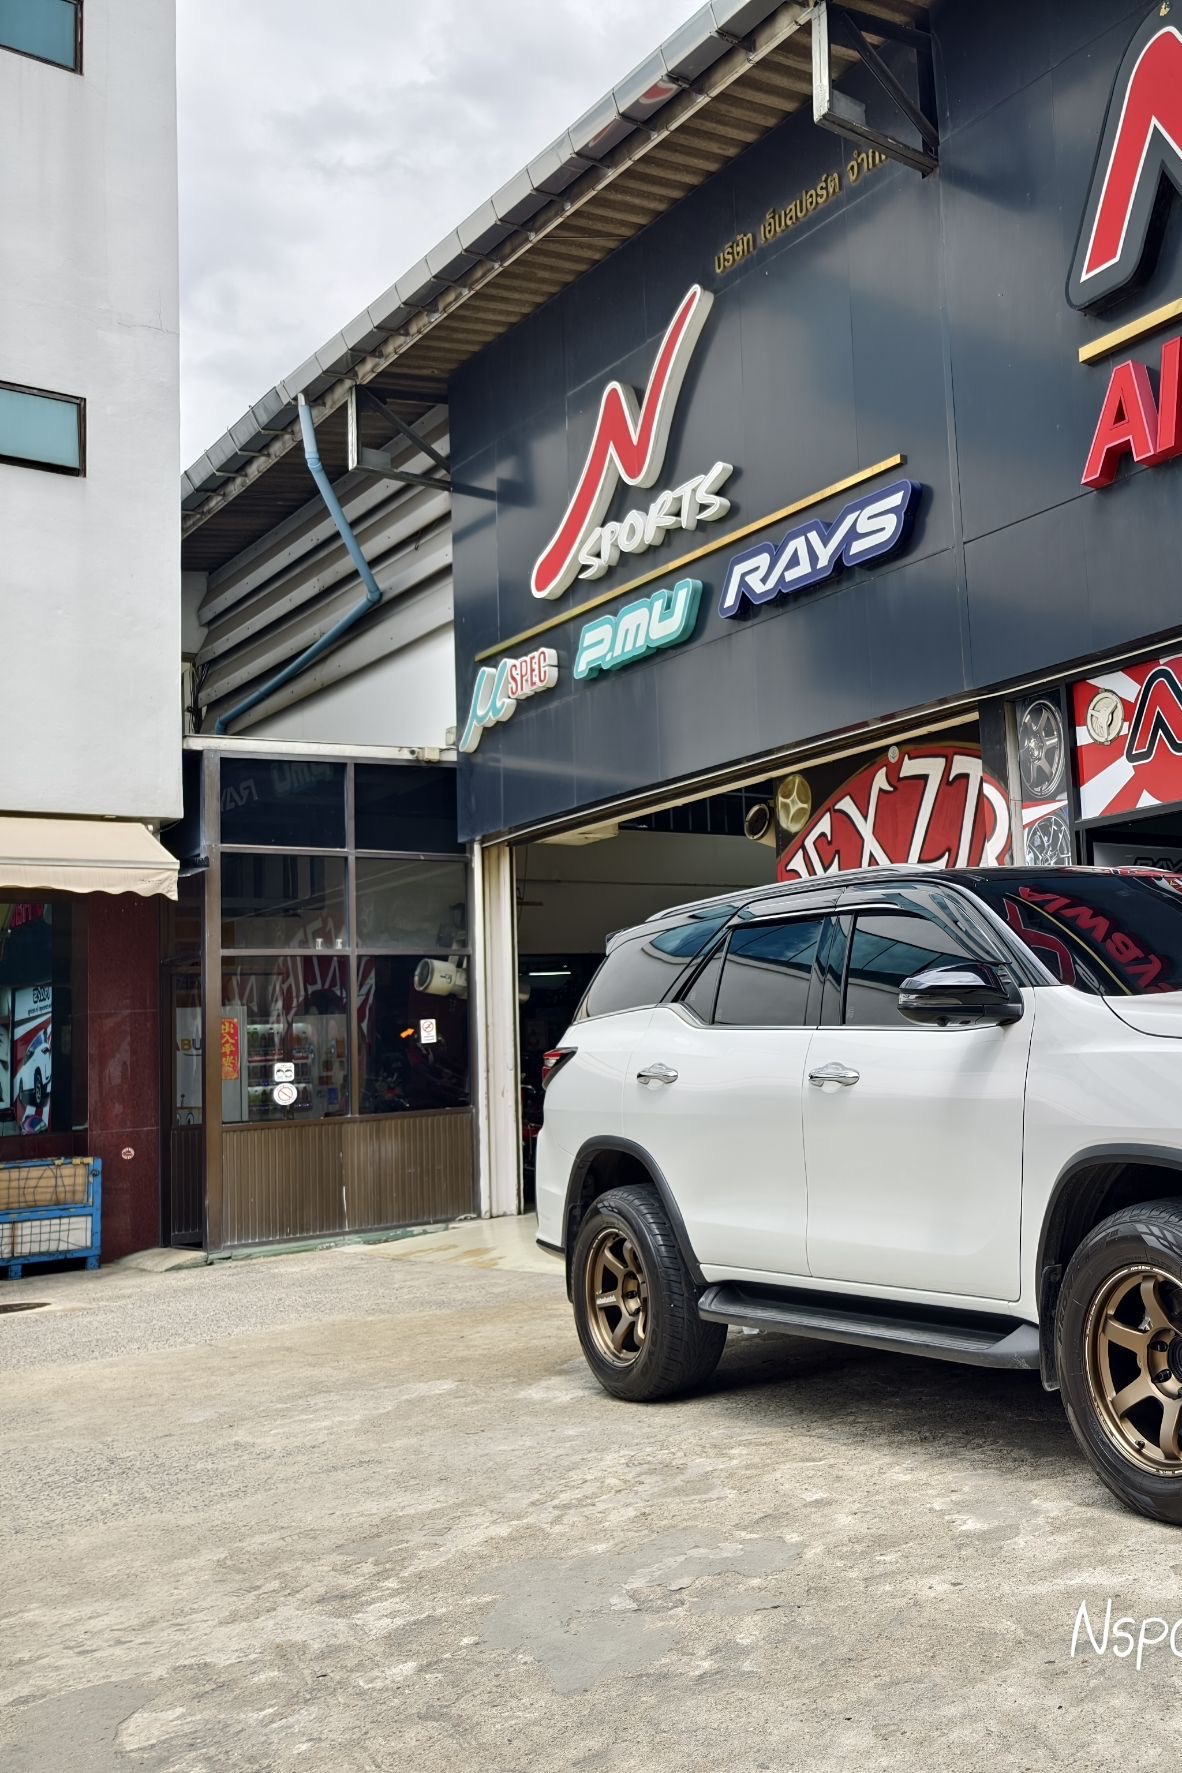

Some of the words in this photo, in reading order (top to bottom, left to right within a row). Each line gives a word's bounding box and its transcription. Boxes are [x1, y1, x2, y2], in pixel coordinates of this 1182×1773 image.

[714, 232, 754, 274] บริษัท
[760, 171, 841, 244] เอ็นสปอร์ต
[578, 462, 734, 580] SPORTS
[718, 480, 920, 619] RAYS
